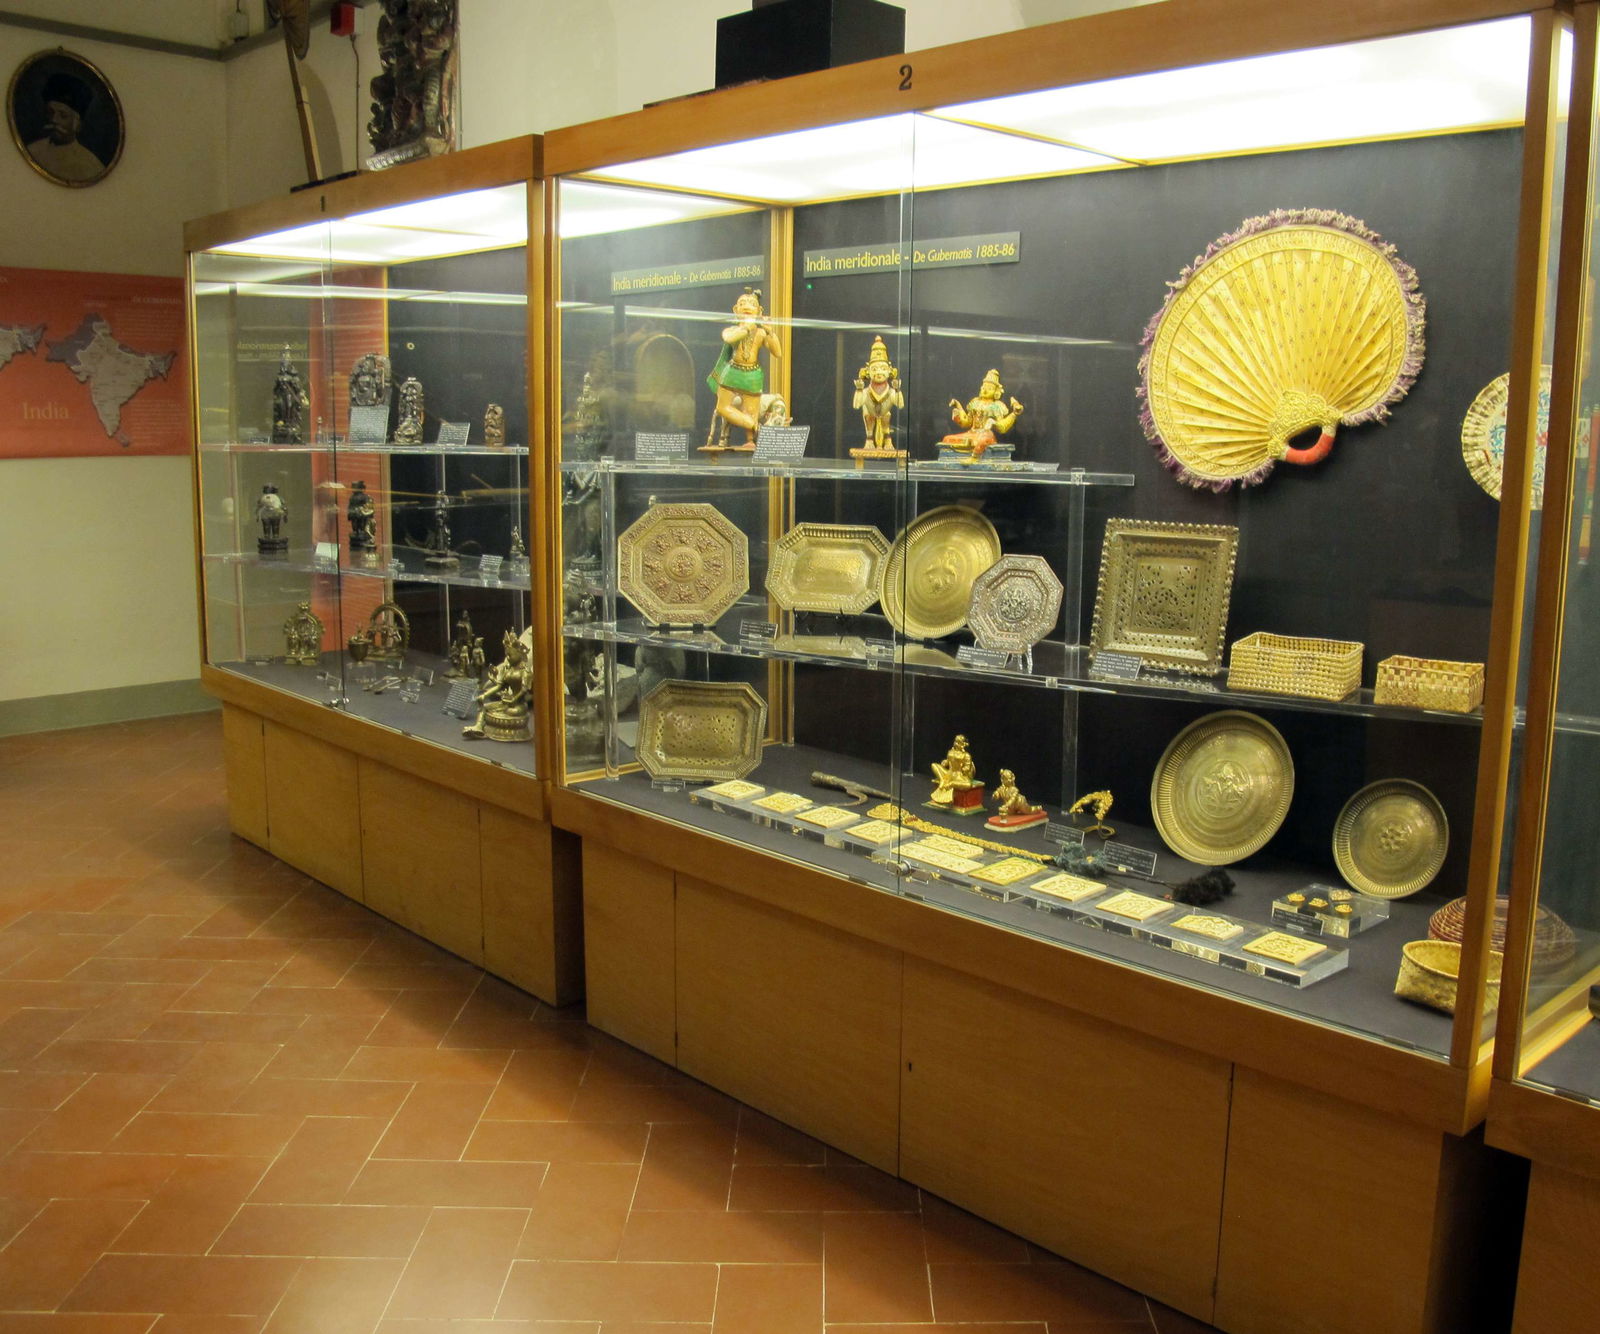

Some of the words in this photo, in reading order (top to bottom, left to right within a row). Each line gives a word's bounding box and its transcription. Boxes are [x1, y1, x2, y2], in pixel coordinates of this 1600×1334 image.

[899, 64, 913, 91] 2
[806, 256, 832, 272] India
[834, 248, 901, 270] meridionale
[913, 250, 926, 263] De
[927, 248, 973, 262] Gubernatis
[976, 243, 1015, 258] 1885-86
[613, 276, 631, 291] India
[633, 272, 681, 289] meridionale
[733, 265, 761, 278] 1885-86
[22, 401, 70, 420] India
